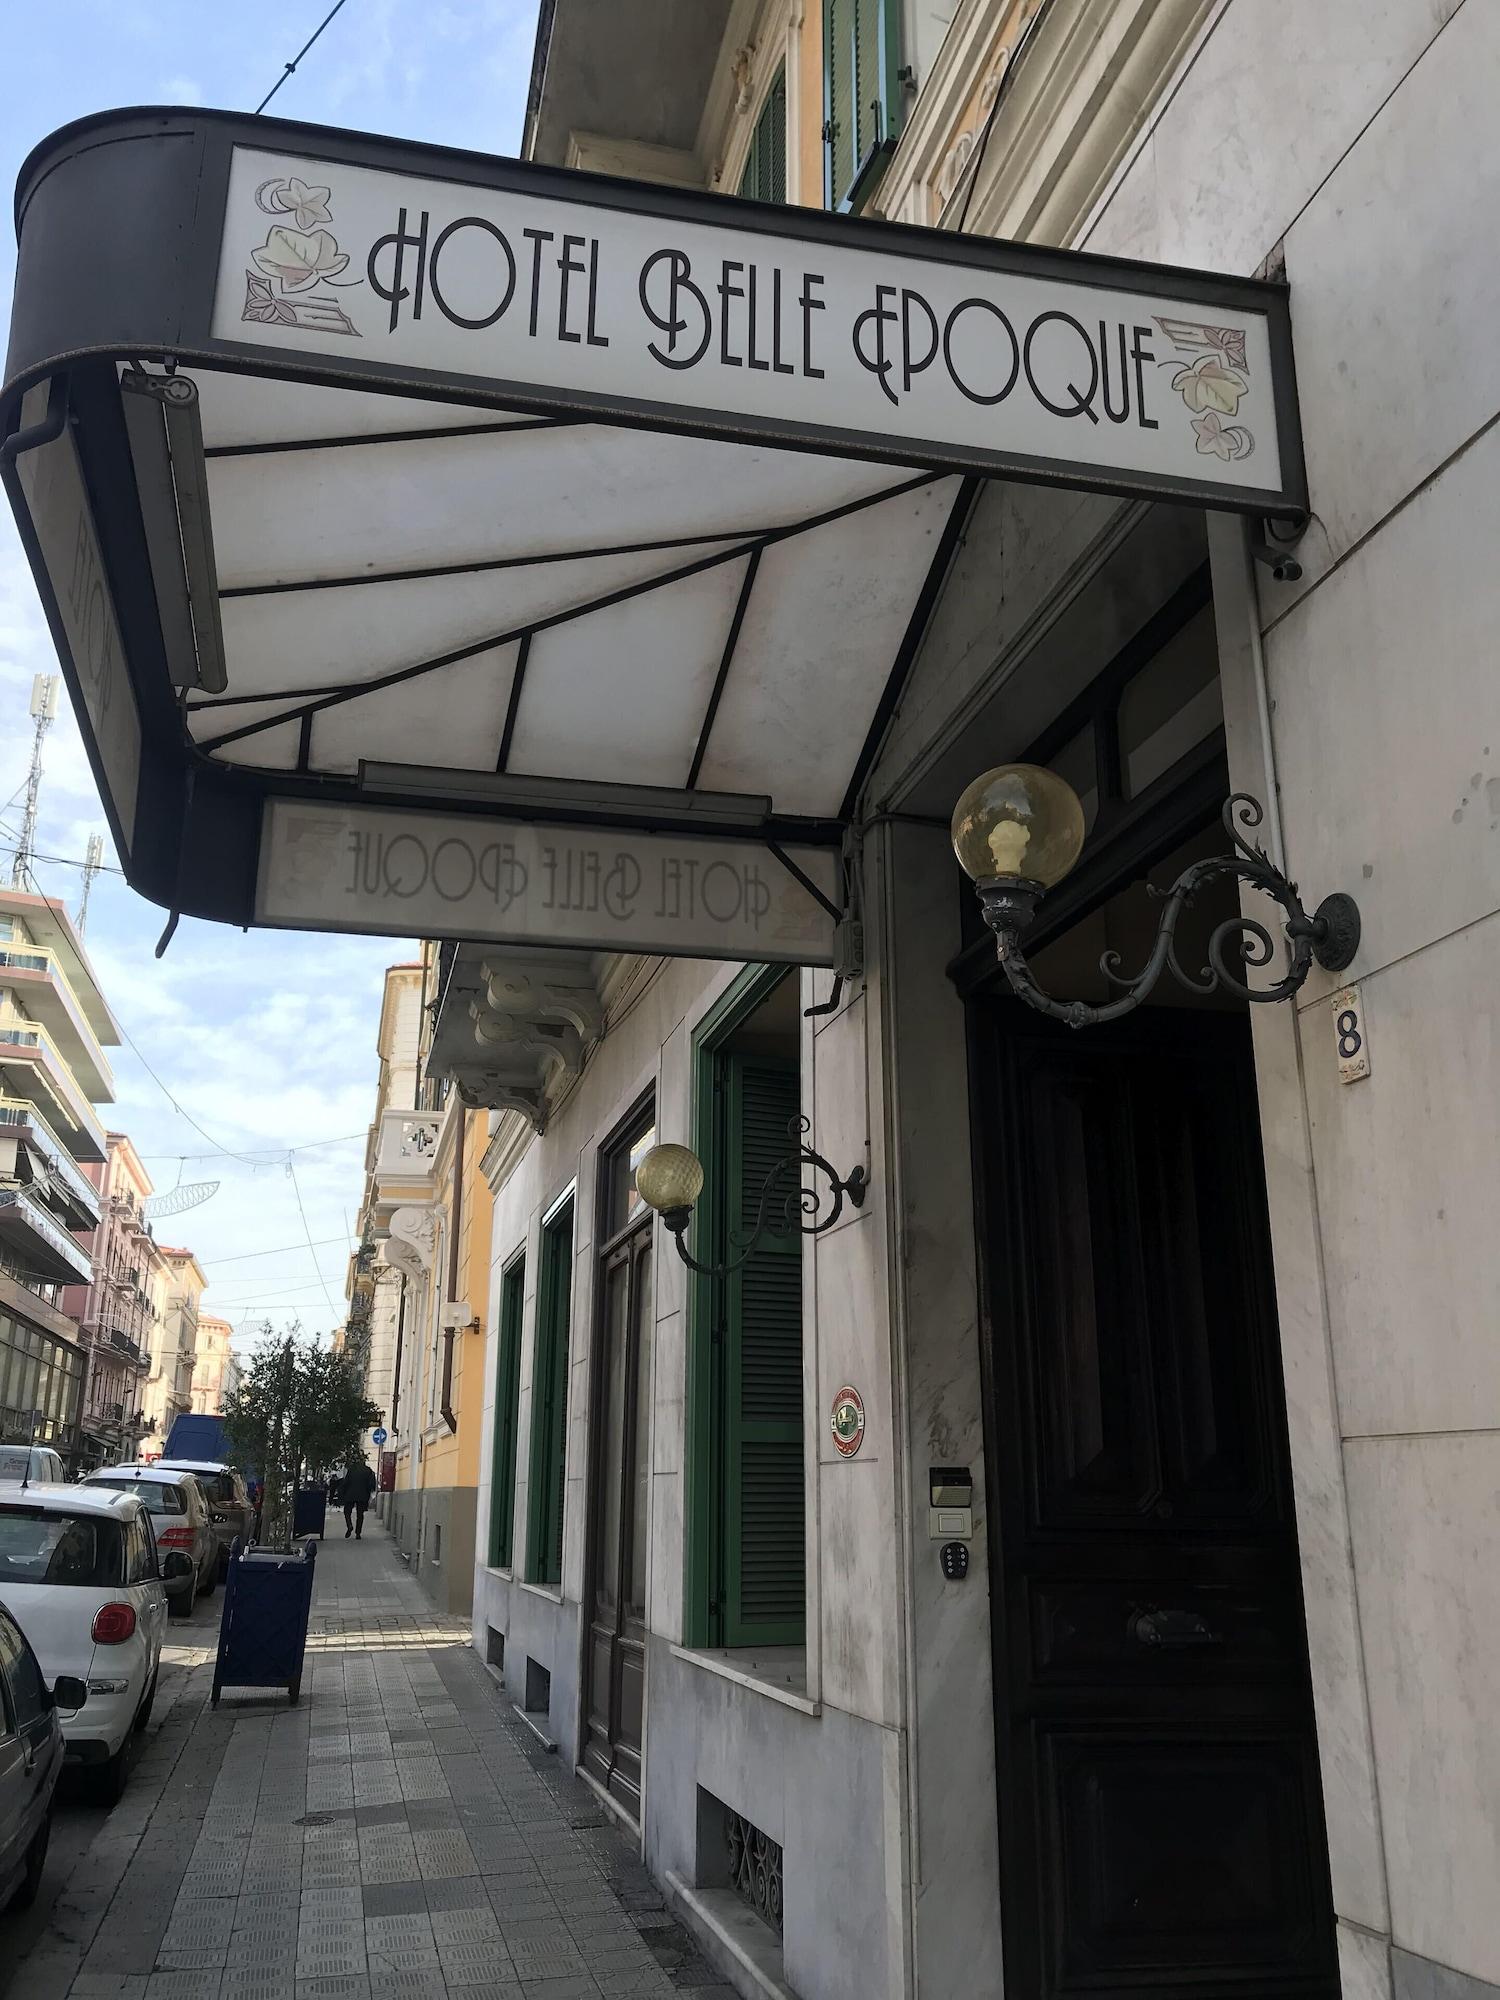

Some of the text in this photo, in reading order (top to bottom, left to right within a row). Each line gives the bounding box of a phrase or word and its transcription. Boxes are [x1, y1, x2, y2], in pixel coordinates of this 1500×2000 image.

[367, 207, 1159, 429] HOTEL BELLE EPOQUE
[1337, 1010, 1361, 1058] 8
